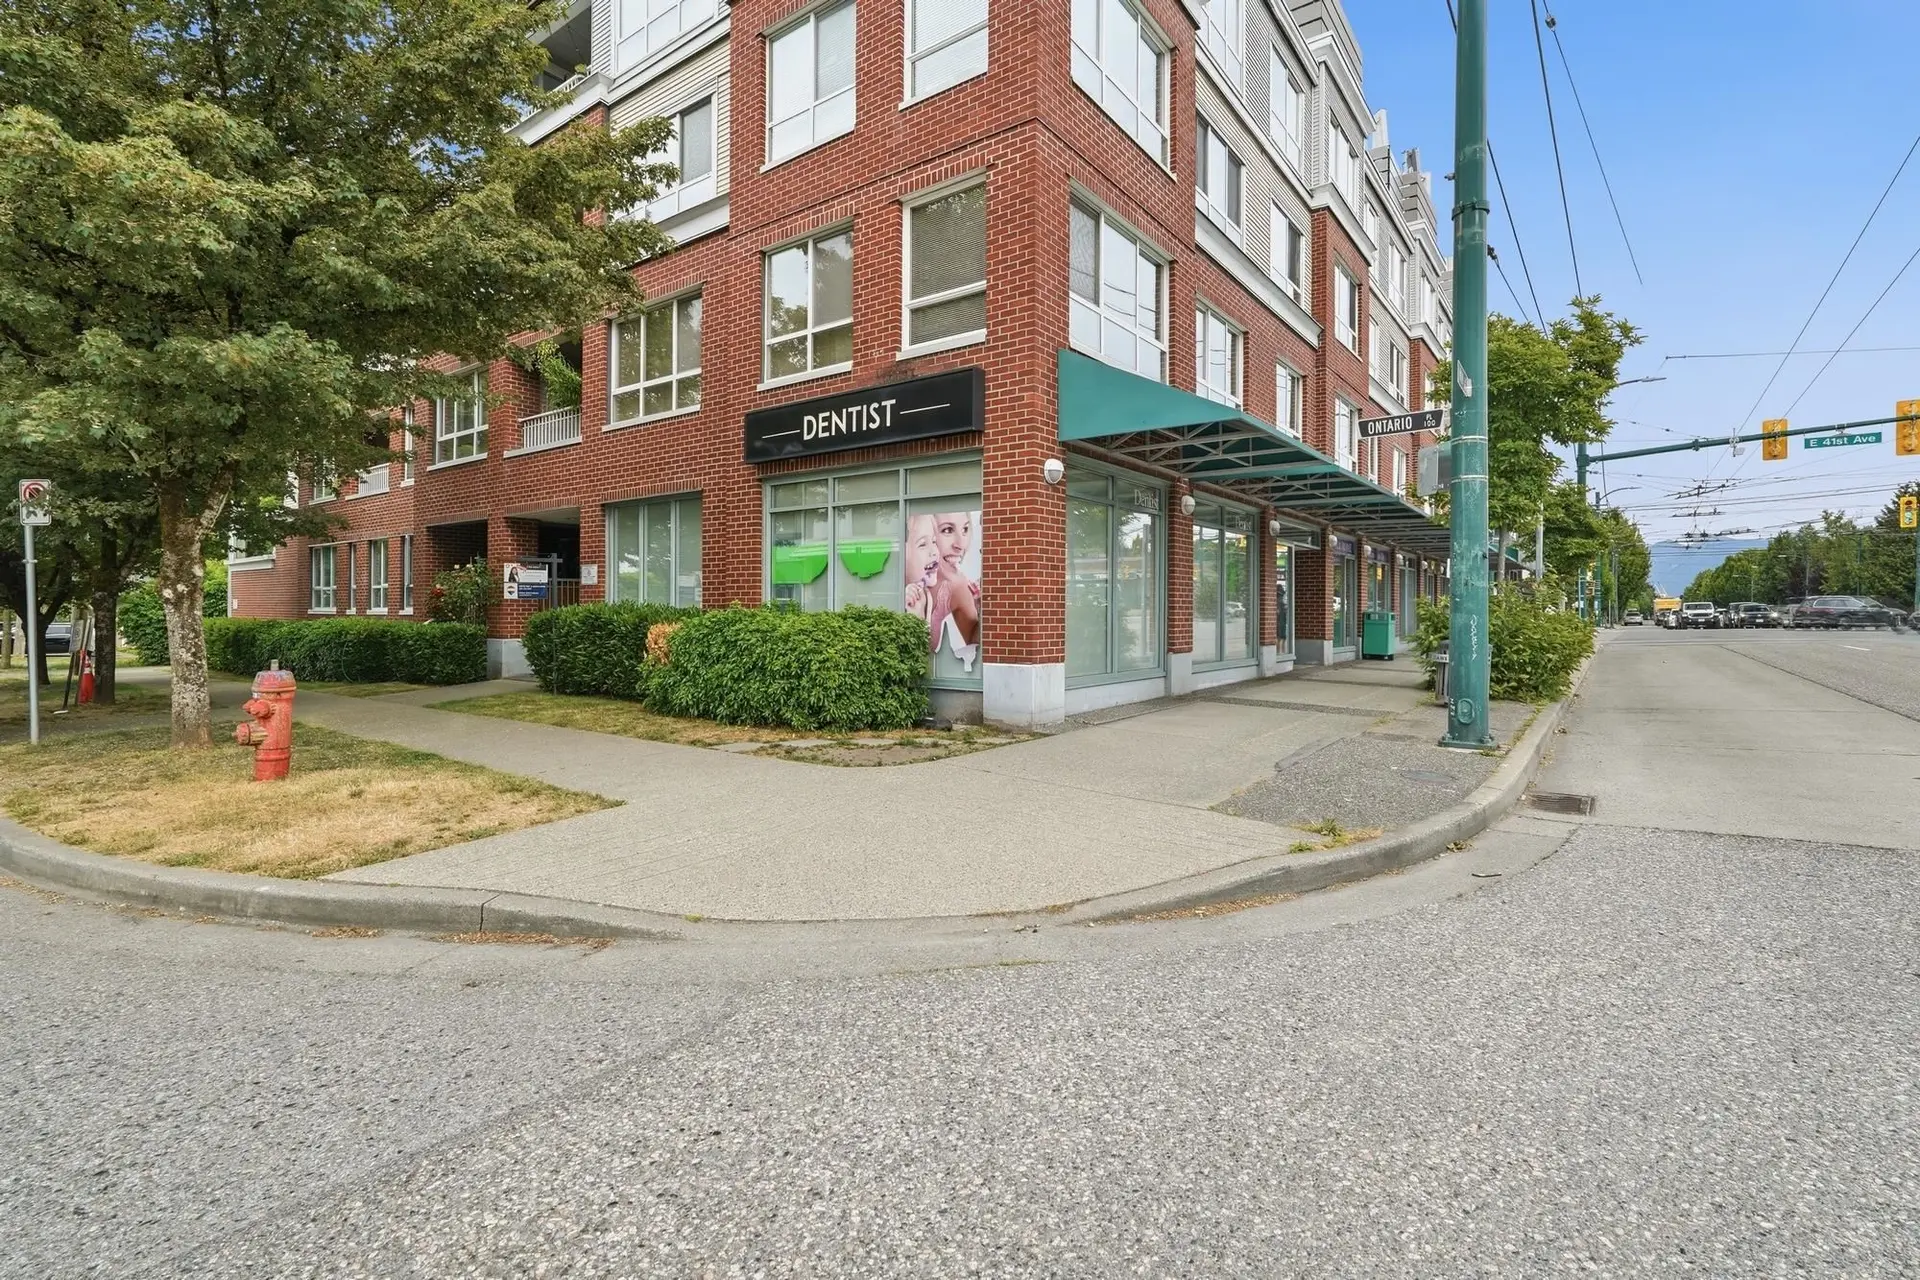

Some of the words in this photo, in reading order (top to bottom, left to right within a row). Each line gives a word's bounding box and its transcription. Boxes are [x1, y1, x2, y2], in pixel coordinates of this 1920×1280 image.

[803, 399, 896, 441] DENTIST
[1367, 416, 1413, 434] ONTARIO
[1424, 419, 1436, 427] 100
[1809, 438, 1818, 447] E
[1822, 436, 1848, 446] 41st
[1853, 434, 1876, 443] Ave
